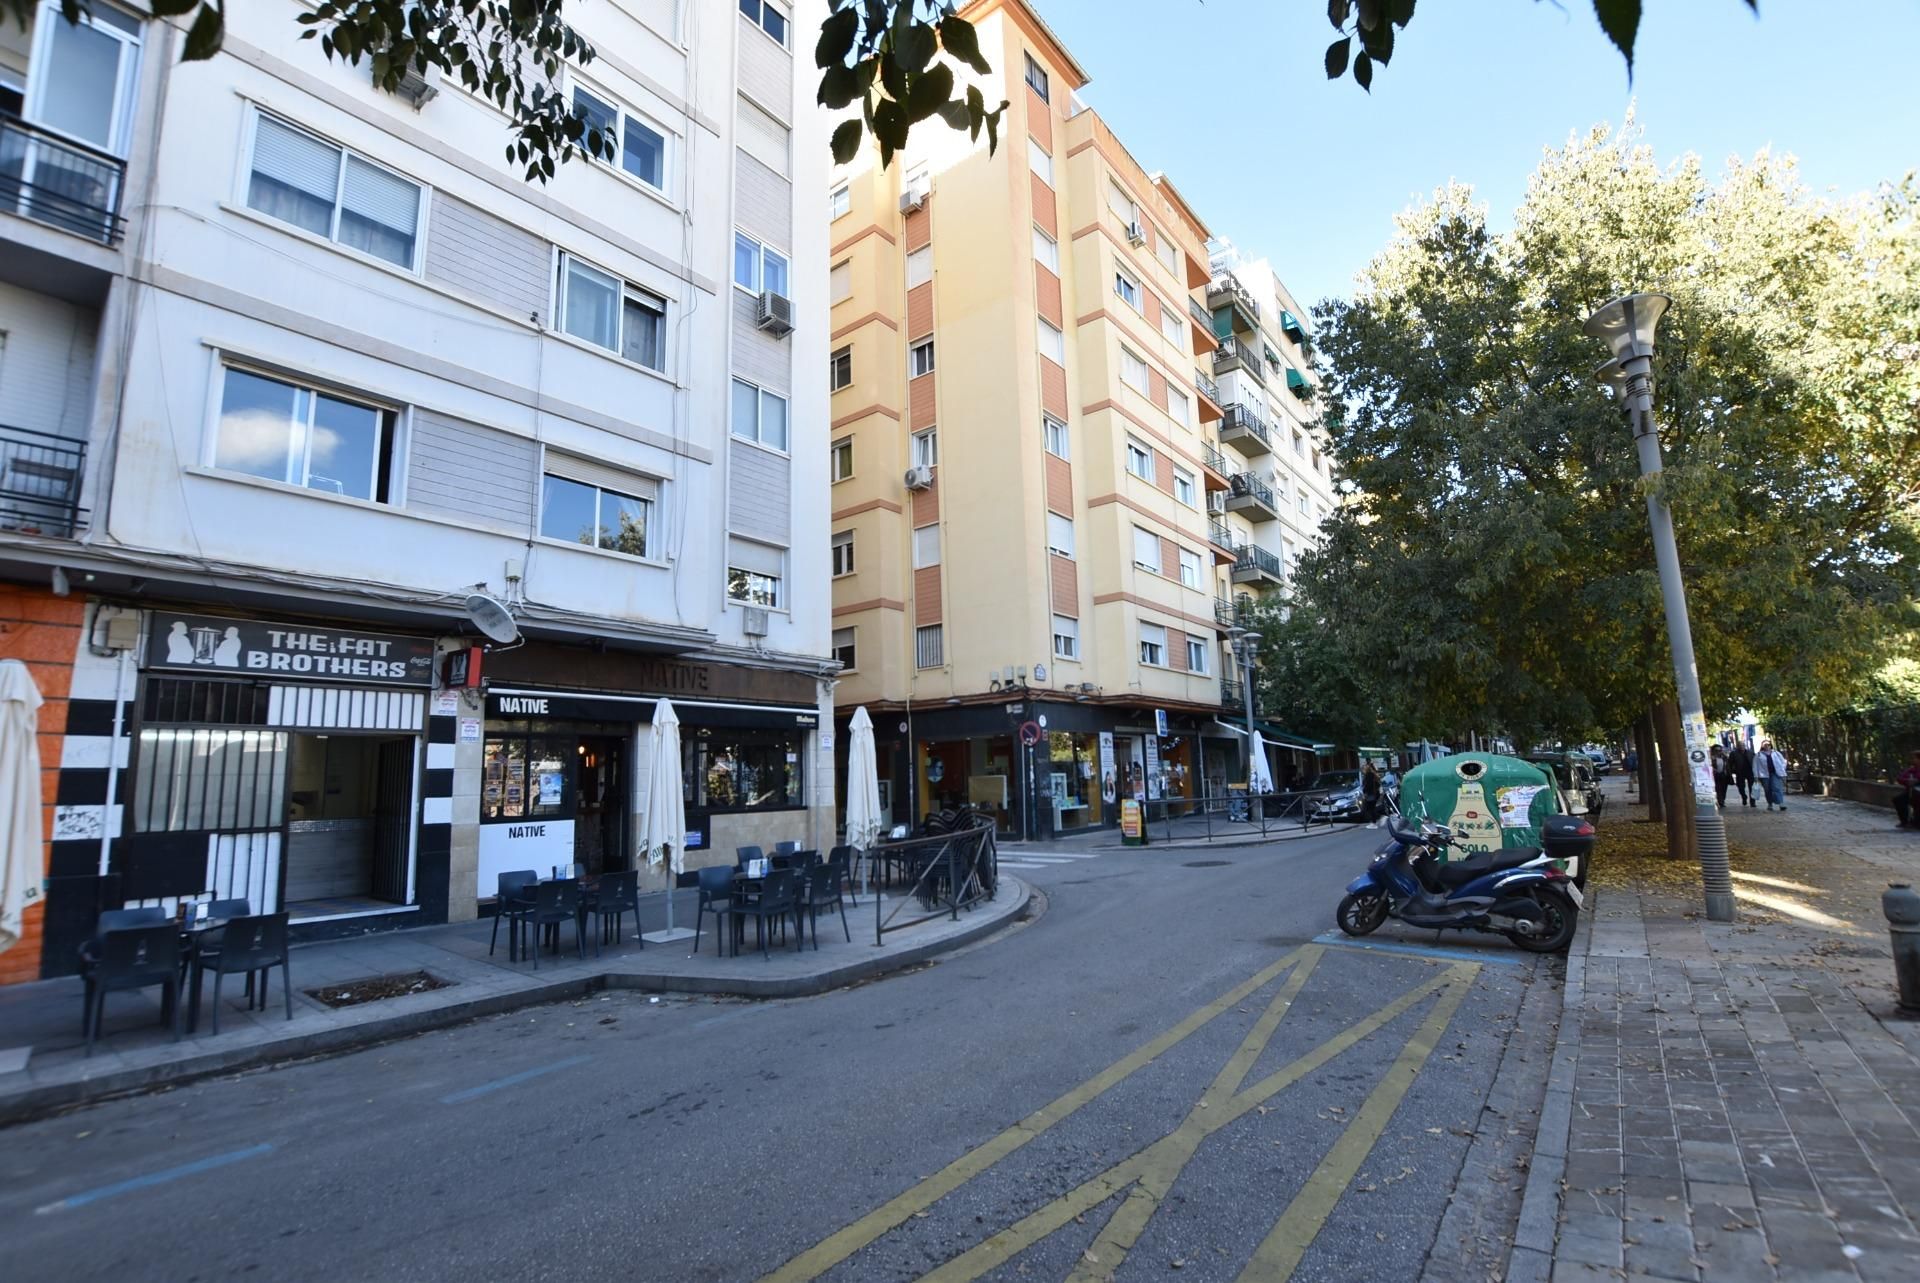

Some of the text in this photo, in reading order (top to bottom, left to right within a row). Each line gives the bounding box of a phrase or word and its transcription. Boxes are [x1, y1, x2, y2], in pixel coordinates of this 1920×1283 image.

[267, 630, 392, 657] THE FAT
[247, 650, 406, 678] BROTHERS
[640, 661, 709, 691] NATIVE
[500, 697, 549, 714] NATIVE
[508, 825, 546, 839] NATIVE
